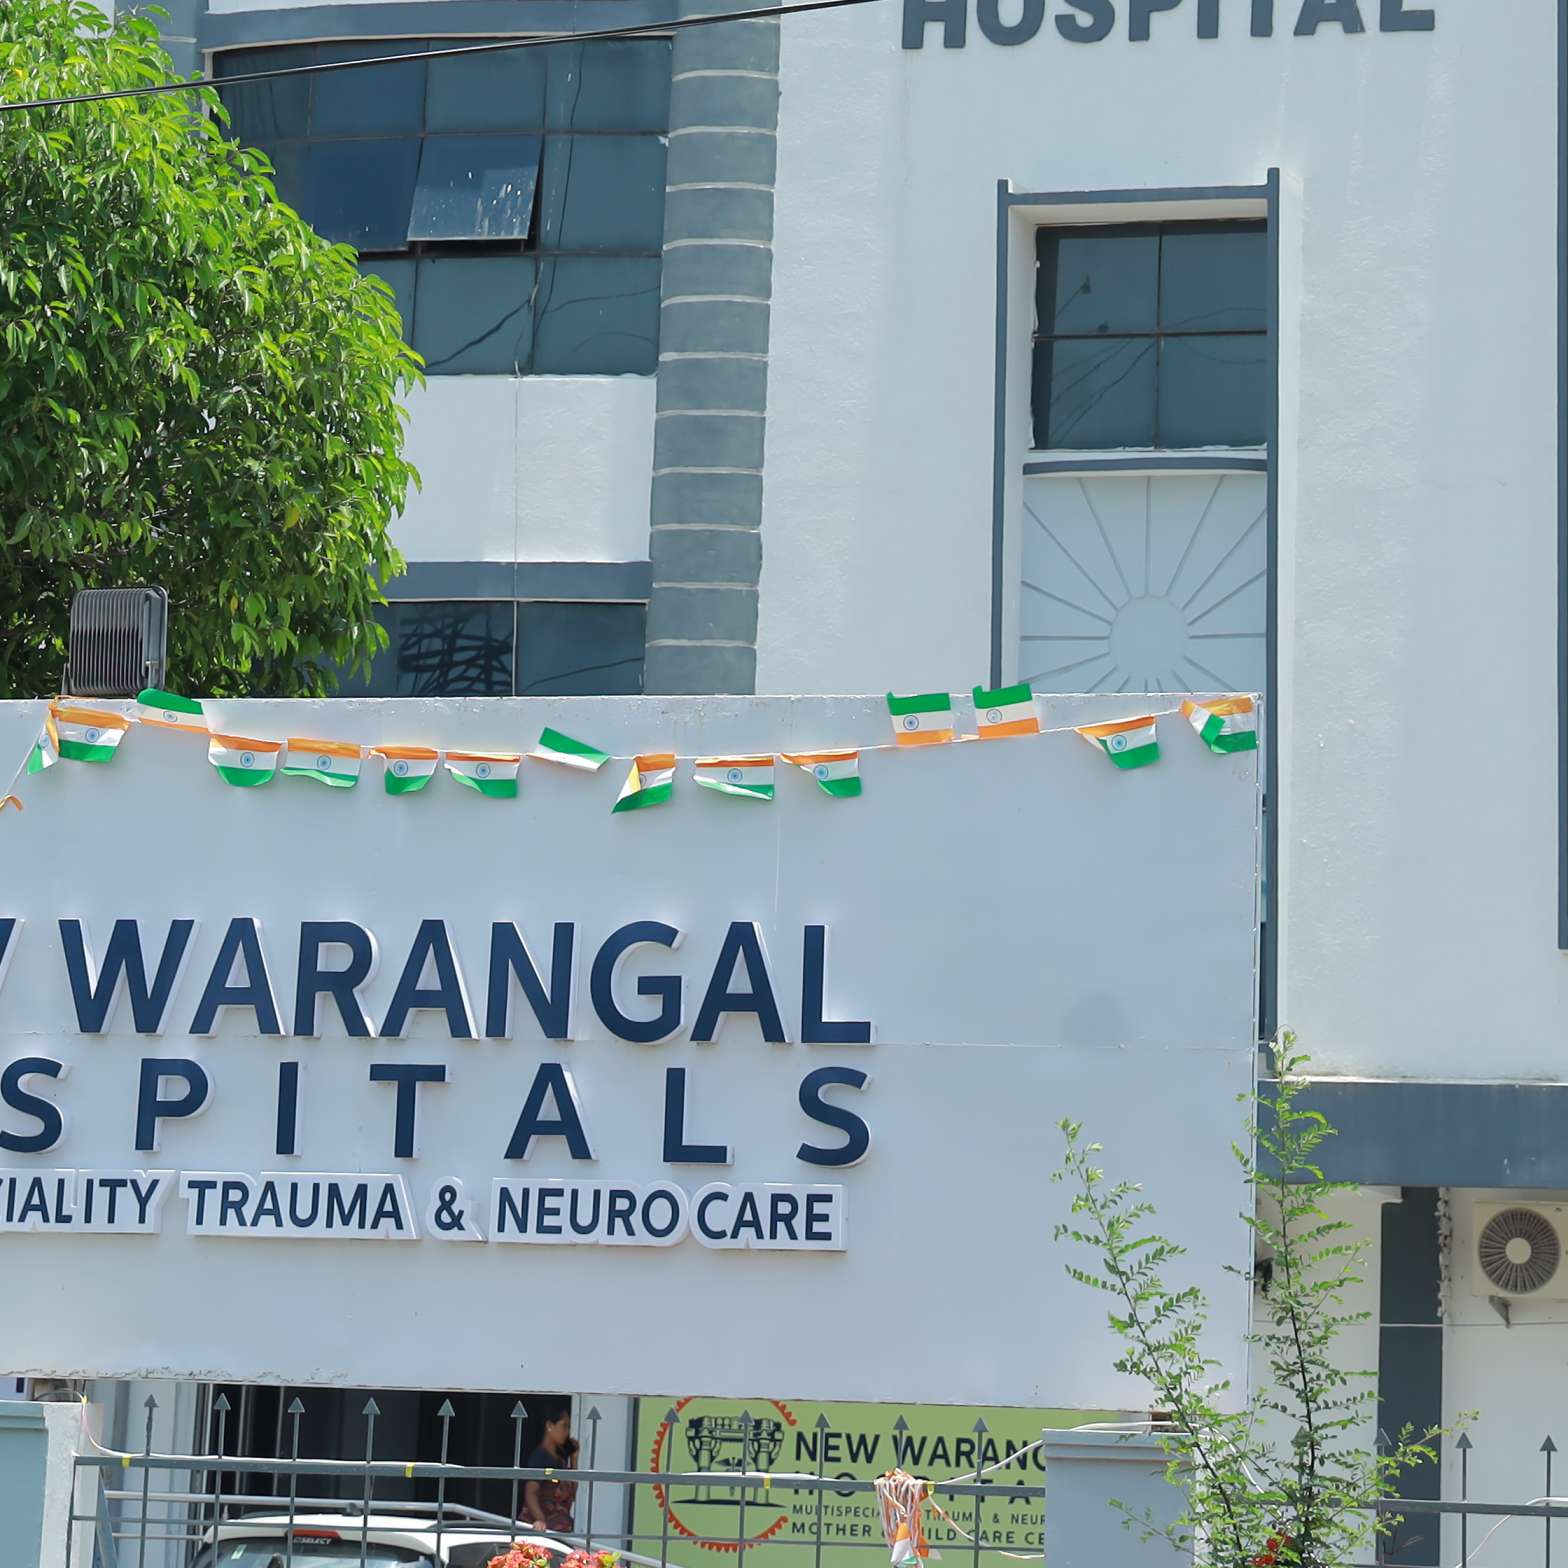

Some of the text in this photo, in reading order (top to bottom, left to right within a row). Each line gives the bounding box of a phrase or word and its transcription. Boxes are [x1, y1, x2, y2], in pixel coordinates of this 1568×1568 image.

[58, 917, 874, 1045] WARANGAL
[187, 1180, 405, 1231] TRAUMA
[434, 1184, 466, 1231] &
[498, 1186, 681, 1236] NEURO
[696, 1192, 834, 1241] CARE
[795, 1431, 880, 1463] NEW
[792, 1521, 872, 1538] MOTHER
